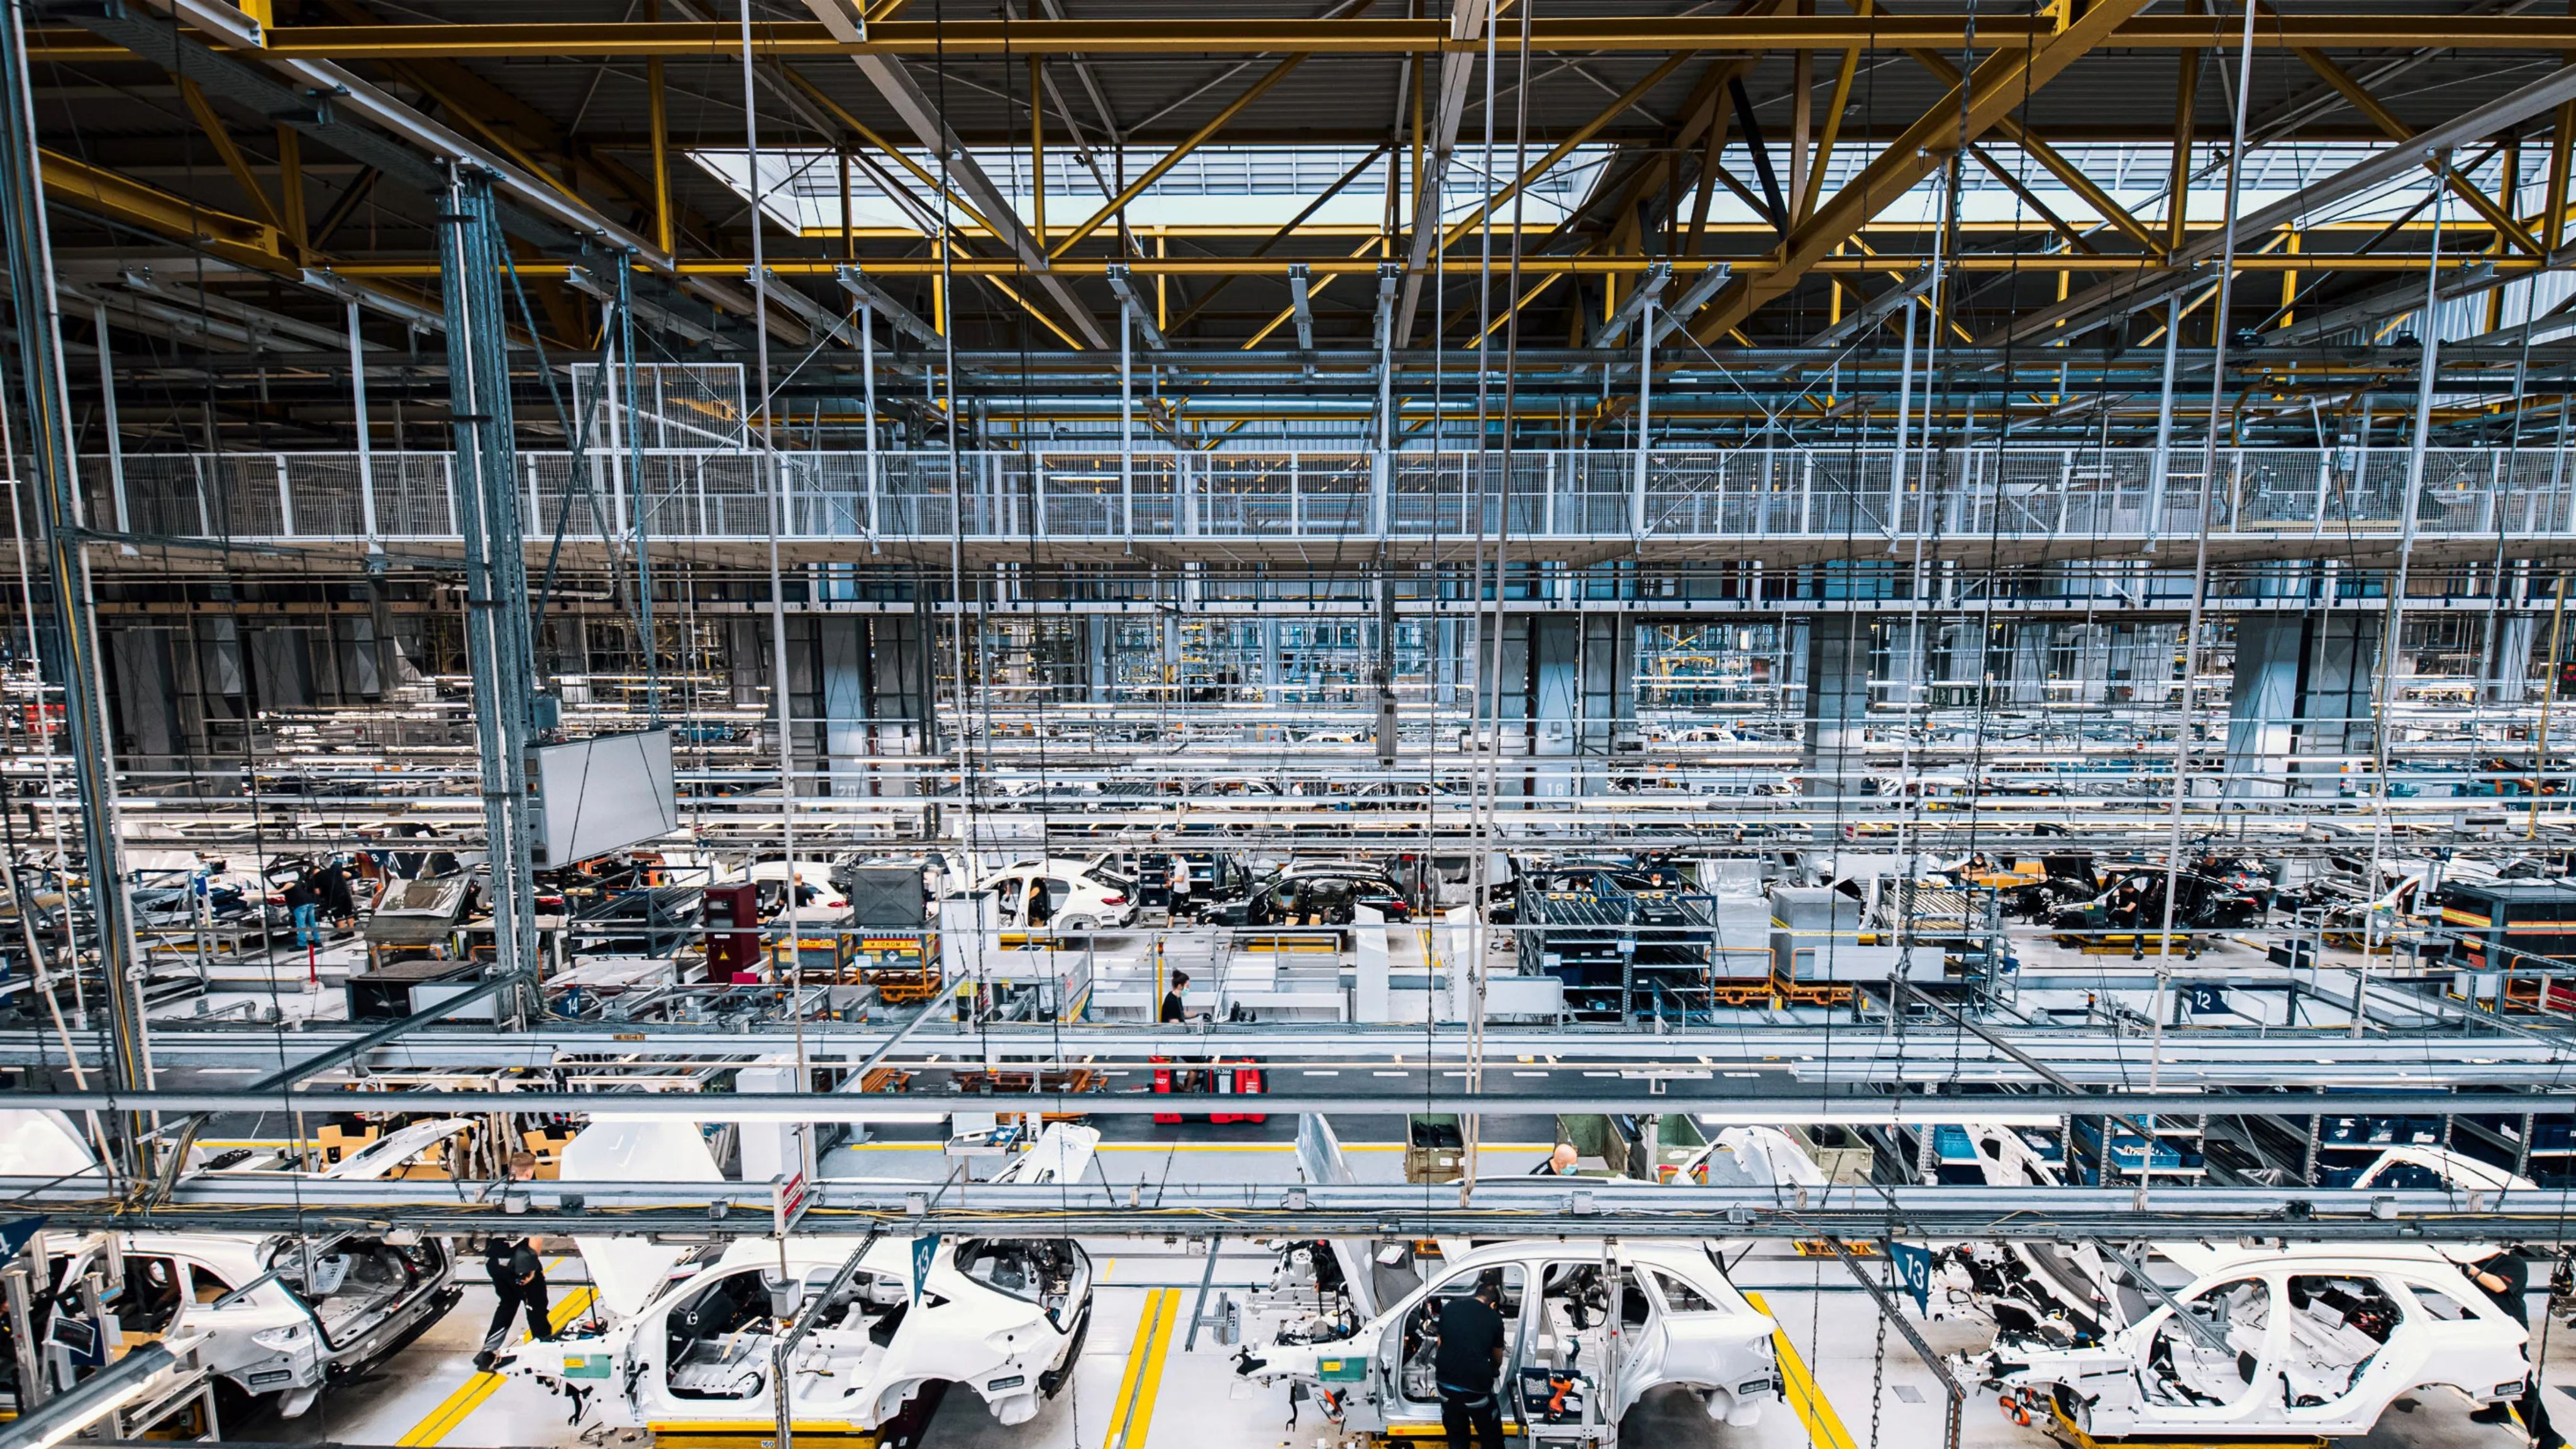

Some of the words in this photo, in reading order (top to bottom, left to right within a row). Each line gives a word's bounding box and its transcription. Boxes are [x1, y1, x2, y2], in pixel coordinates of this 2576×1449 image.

[838, 786, 857, 796] 20
[1547, 783, 1563, 796] 18
[2262, 784, 2279, 796] 16
[371, 853, 379, 862] 8
[2440, 847, 2450, 857] 14
[567, 997, 578, 1014] 14
[1654, 996, 1660, 1014] 13
[2196, 991, 2211, 1009] 12
[916, 1245, 930, 1280] 13
[1906, 1253, 1924, 1290] 13
